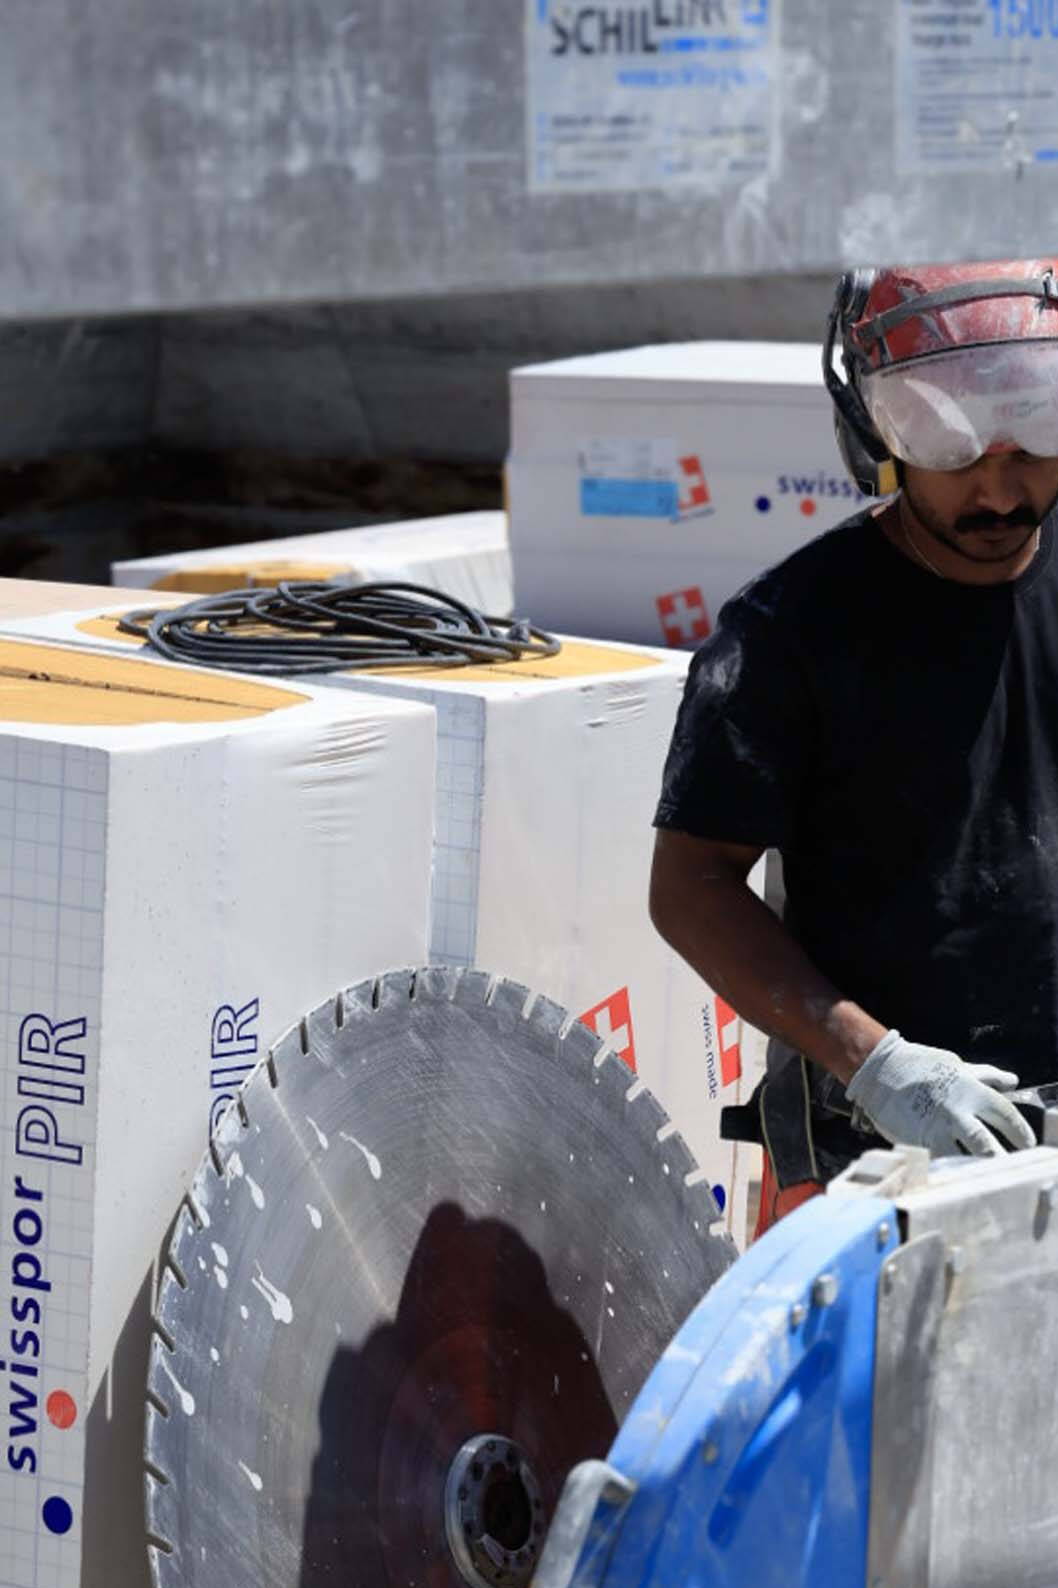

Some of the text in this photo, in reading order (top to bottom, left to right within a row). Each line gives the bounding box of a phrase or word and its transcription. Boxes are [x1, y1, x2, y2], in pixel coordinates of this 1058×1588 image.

[706, 1051, 717, 1099] made
[0, 1013, 86, 1473] swisspor PIR
